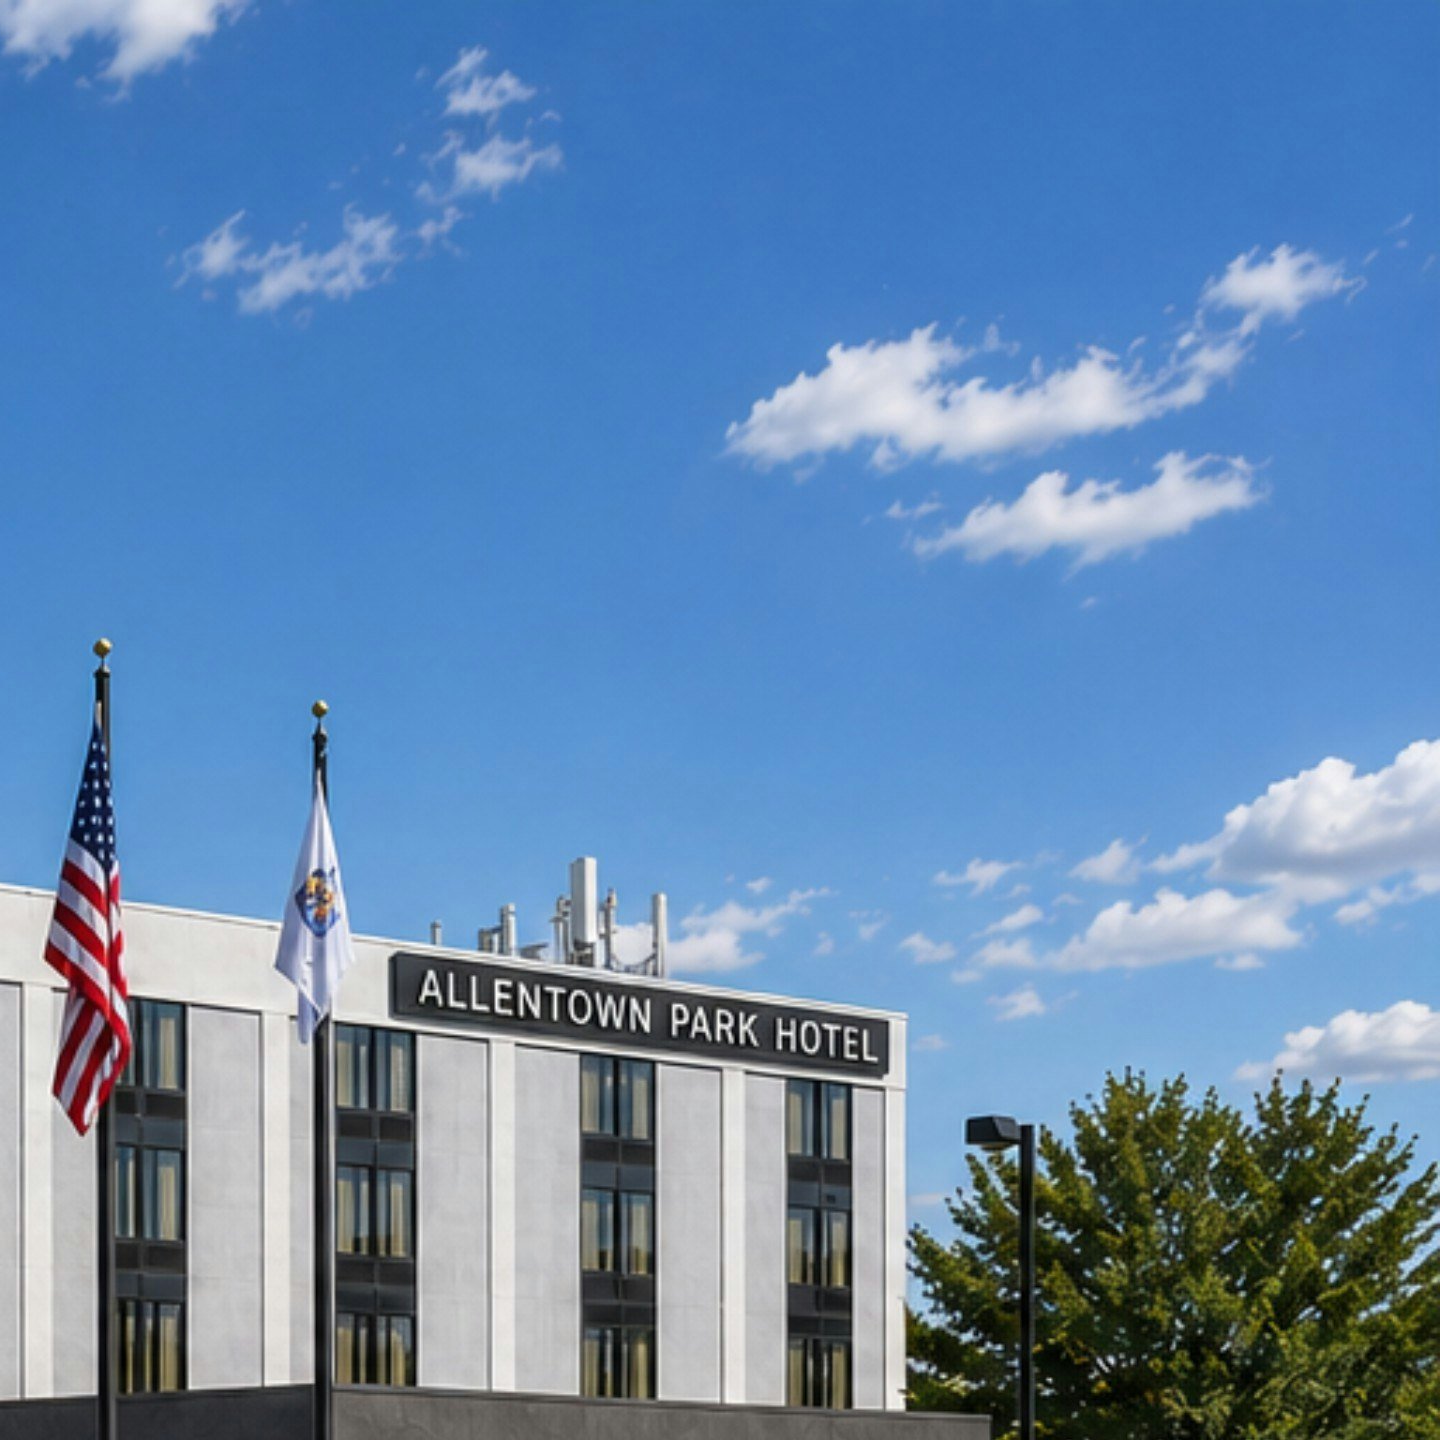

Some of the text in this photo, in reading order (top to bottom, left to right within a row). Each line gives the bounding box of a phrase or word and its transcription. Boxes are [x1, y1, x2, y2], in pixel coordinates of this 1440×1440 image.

[418, 968, 880, 1064] ALLENTOWN PARK HOTEL
